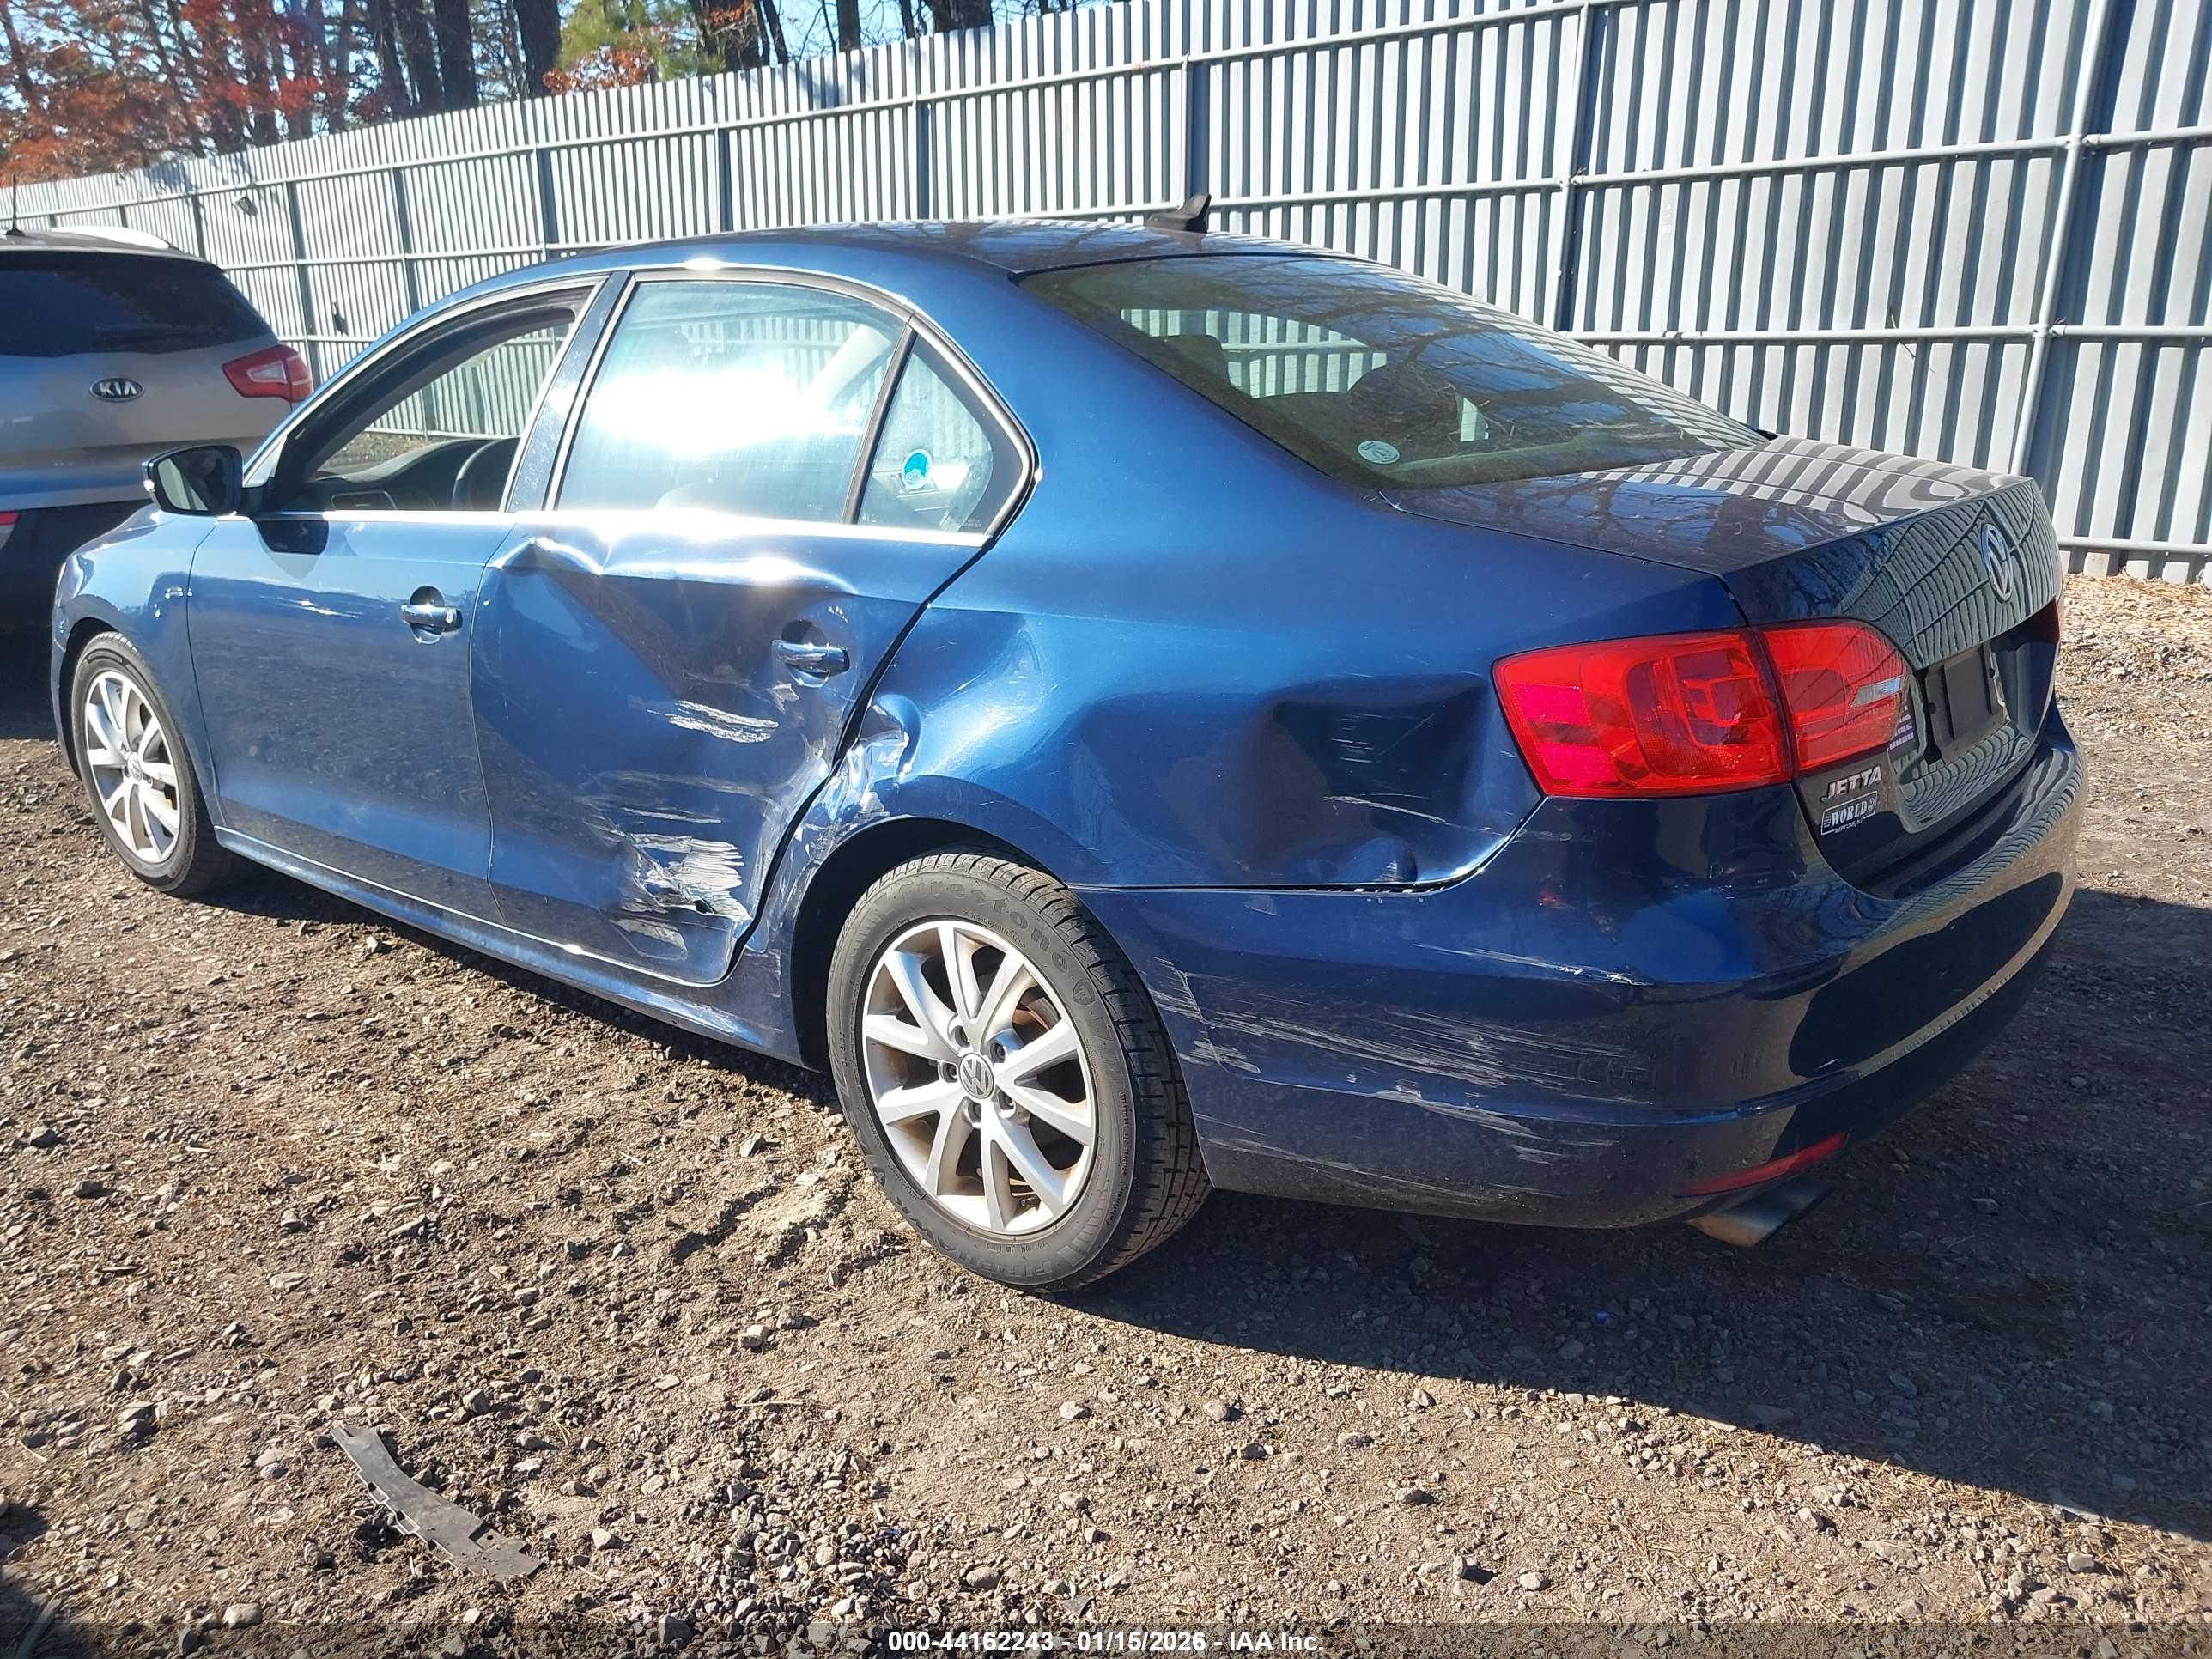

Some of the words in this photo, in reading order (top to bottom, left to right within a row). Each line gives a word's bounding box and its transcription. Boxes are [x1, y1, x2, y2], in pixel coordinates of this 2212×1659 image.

[99, 381, 137, 396] KIA
[1819, 765, 1882, 804] JETTA
[1832, 801, 1868, 827] WORLD
[898, 880, 1069, 974] Firestone
